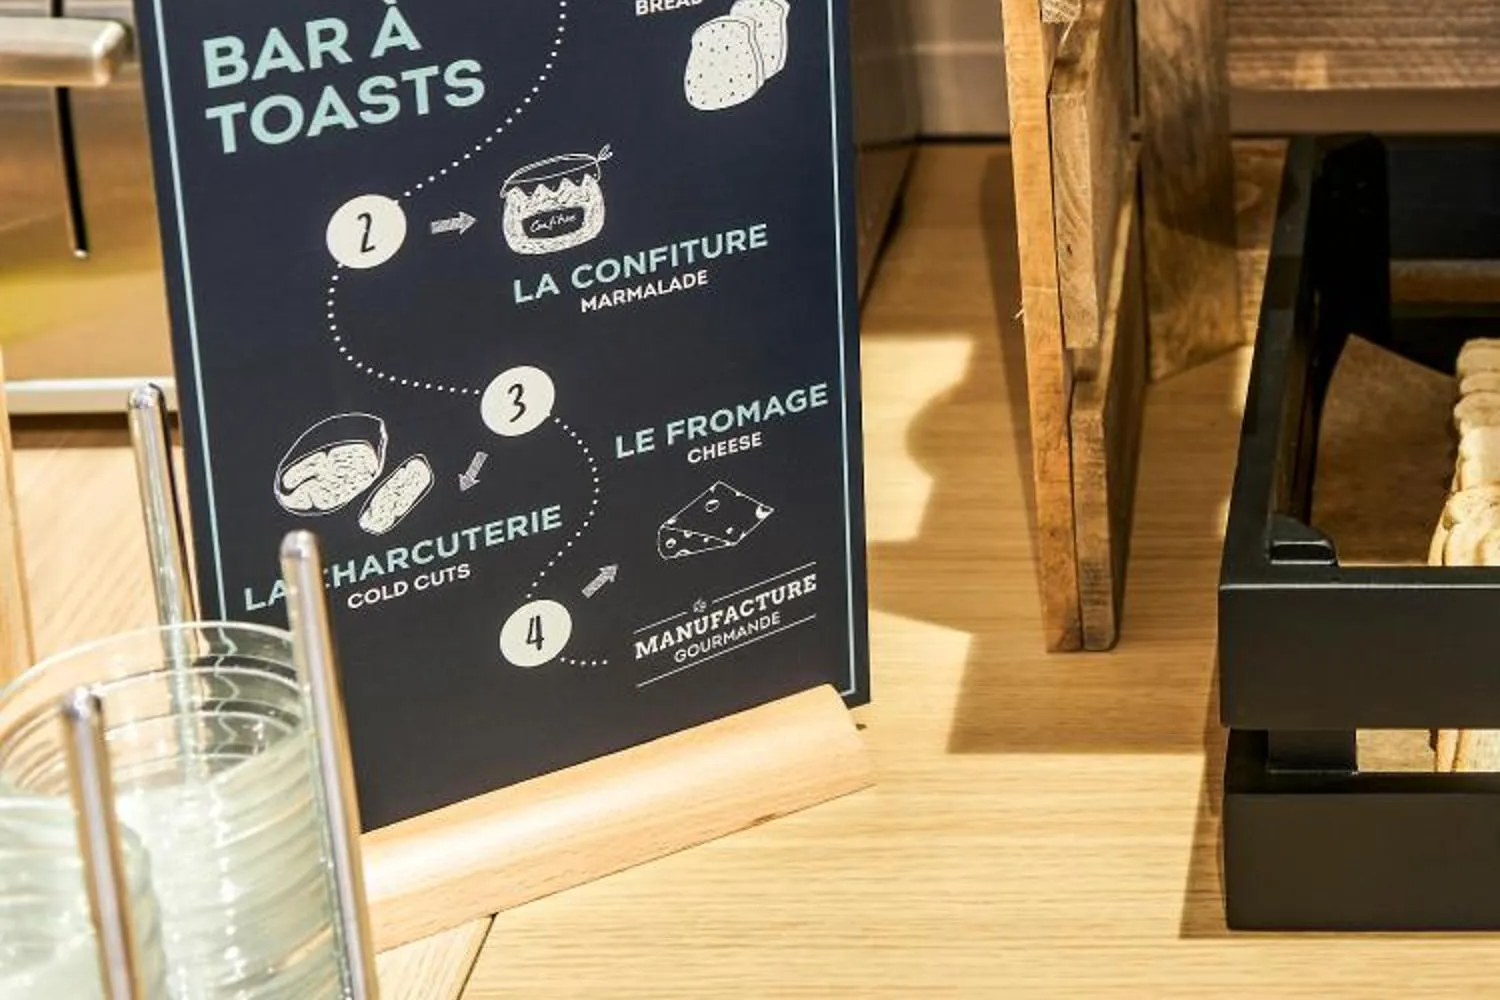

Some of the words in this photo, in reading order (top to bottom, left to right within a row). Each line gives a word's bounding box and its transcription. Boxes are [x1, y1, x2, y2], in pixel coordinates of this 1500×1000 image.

[203, 17, 350, 89] BAR
[205, 59, 486, 154] TOASTS
[358, 212, 377, 252] 2
[513, 272, 559, 303] LA
[570, 224, 768, 291] CONFITURE
[580, 270, 708, 313] MARMALADE
[507, 384, 525, 421] 3
[615, 430, 654, 459] LE
[666, 384, 828, 447] FROMAGE
[687, 431, 762, 465] CHEESE
[324, 505, 562, 589] HARCUTERIE
[347, 581, 409, 609] COLD
[414, 563, 471, 590] CUTS
[525, 615, 545, 651] 4
[635, 573, 818, 660] MANUFACTURE
[673, 611, 781, 664] GOURMANDE
